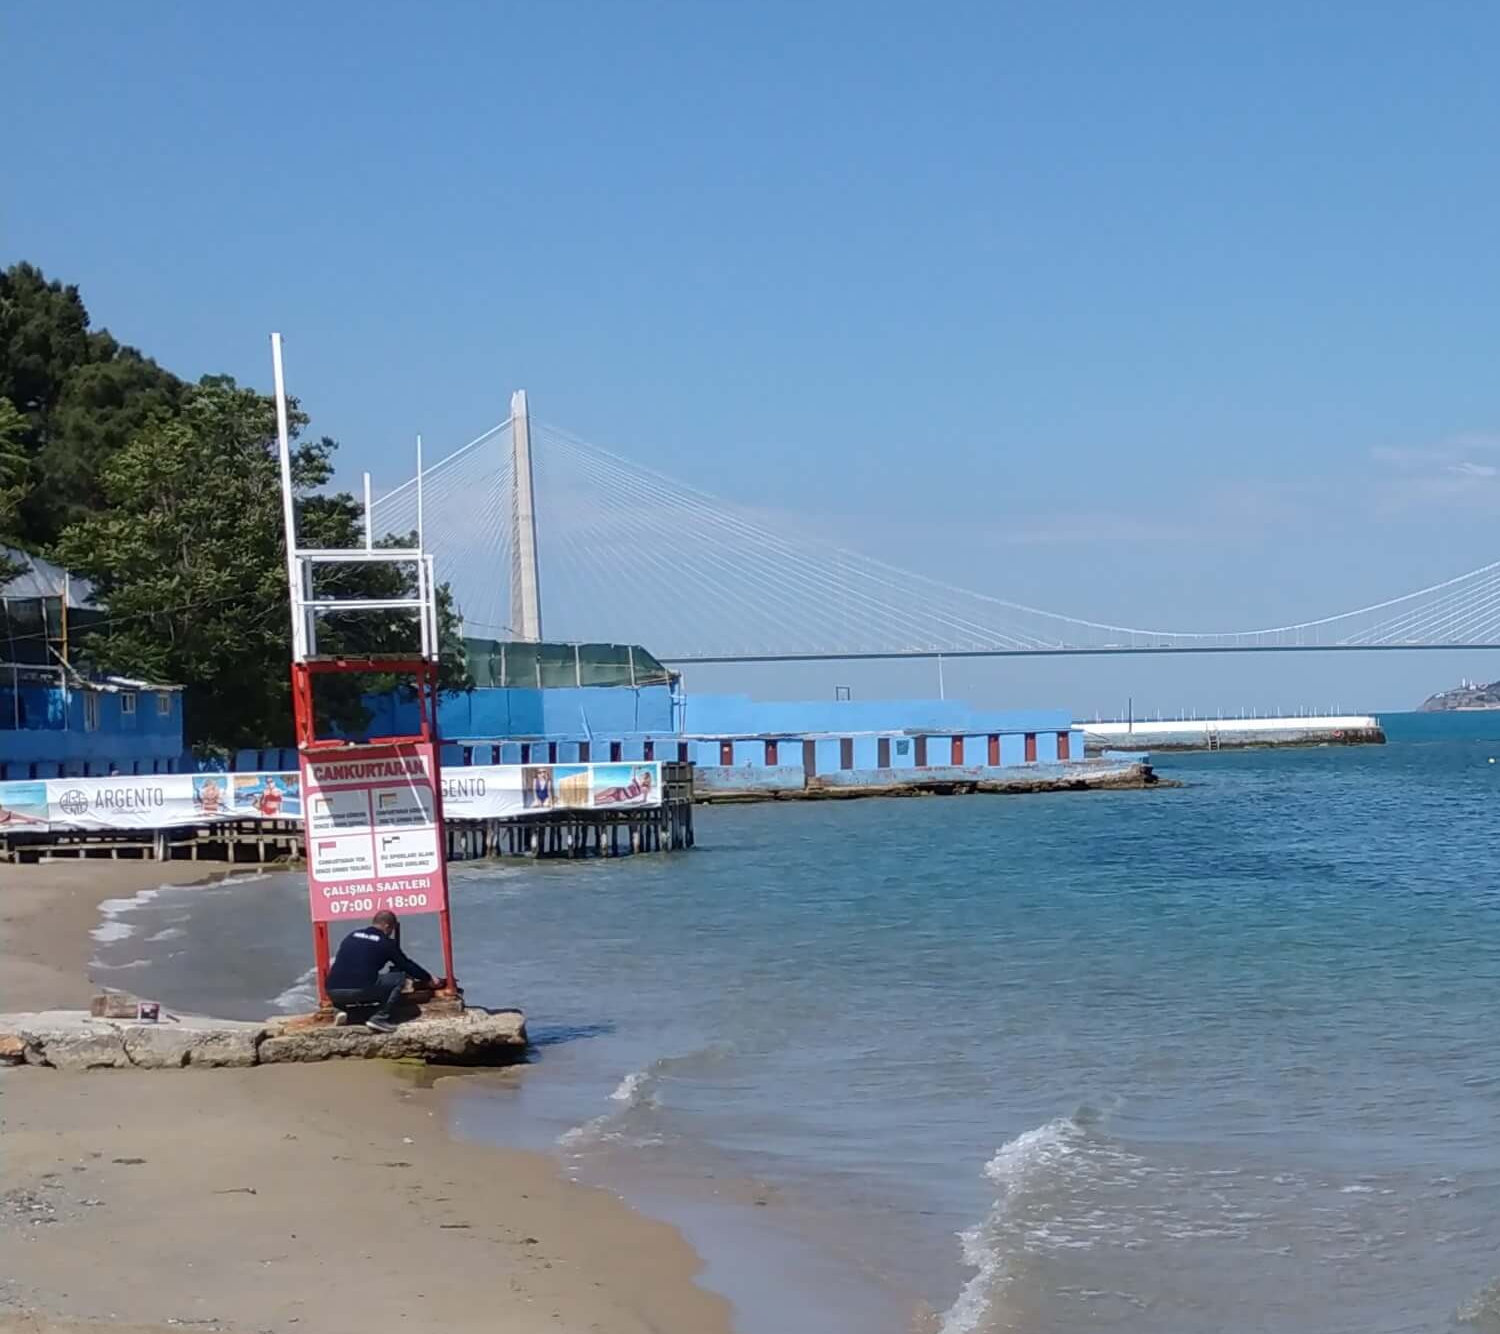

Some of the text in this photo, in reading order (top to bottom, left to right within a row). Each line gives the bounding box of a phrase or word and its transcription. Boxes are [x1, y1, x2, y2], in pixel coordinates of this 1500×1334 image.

[313, 758, 425, 781] CANKURTARAN
[440, 777, 486, 797] GENTO
[95, 787, 164, 809] ARGENTO
[323, 877, 431, 898] ÇALIŞMA SAATLERİ
[330, 898, 373, 914] 07:00
[386, 894, 427, 909] 18:00
